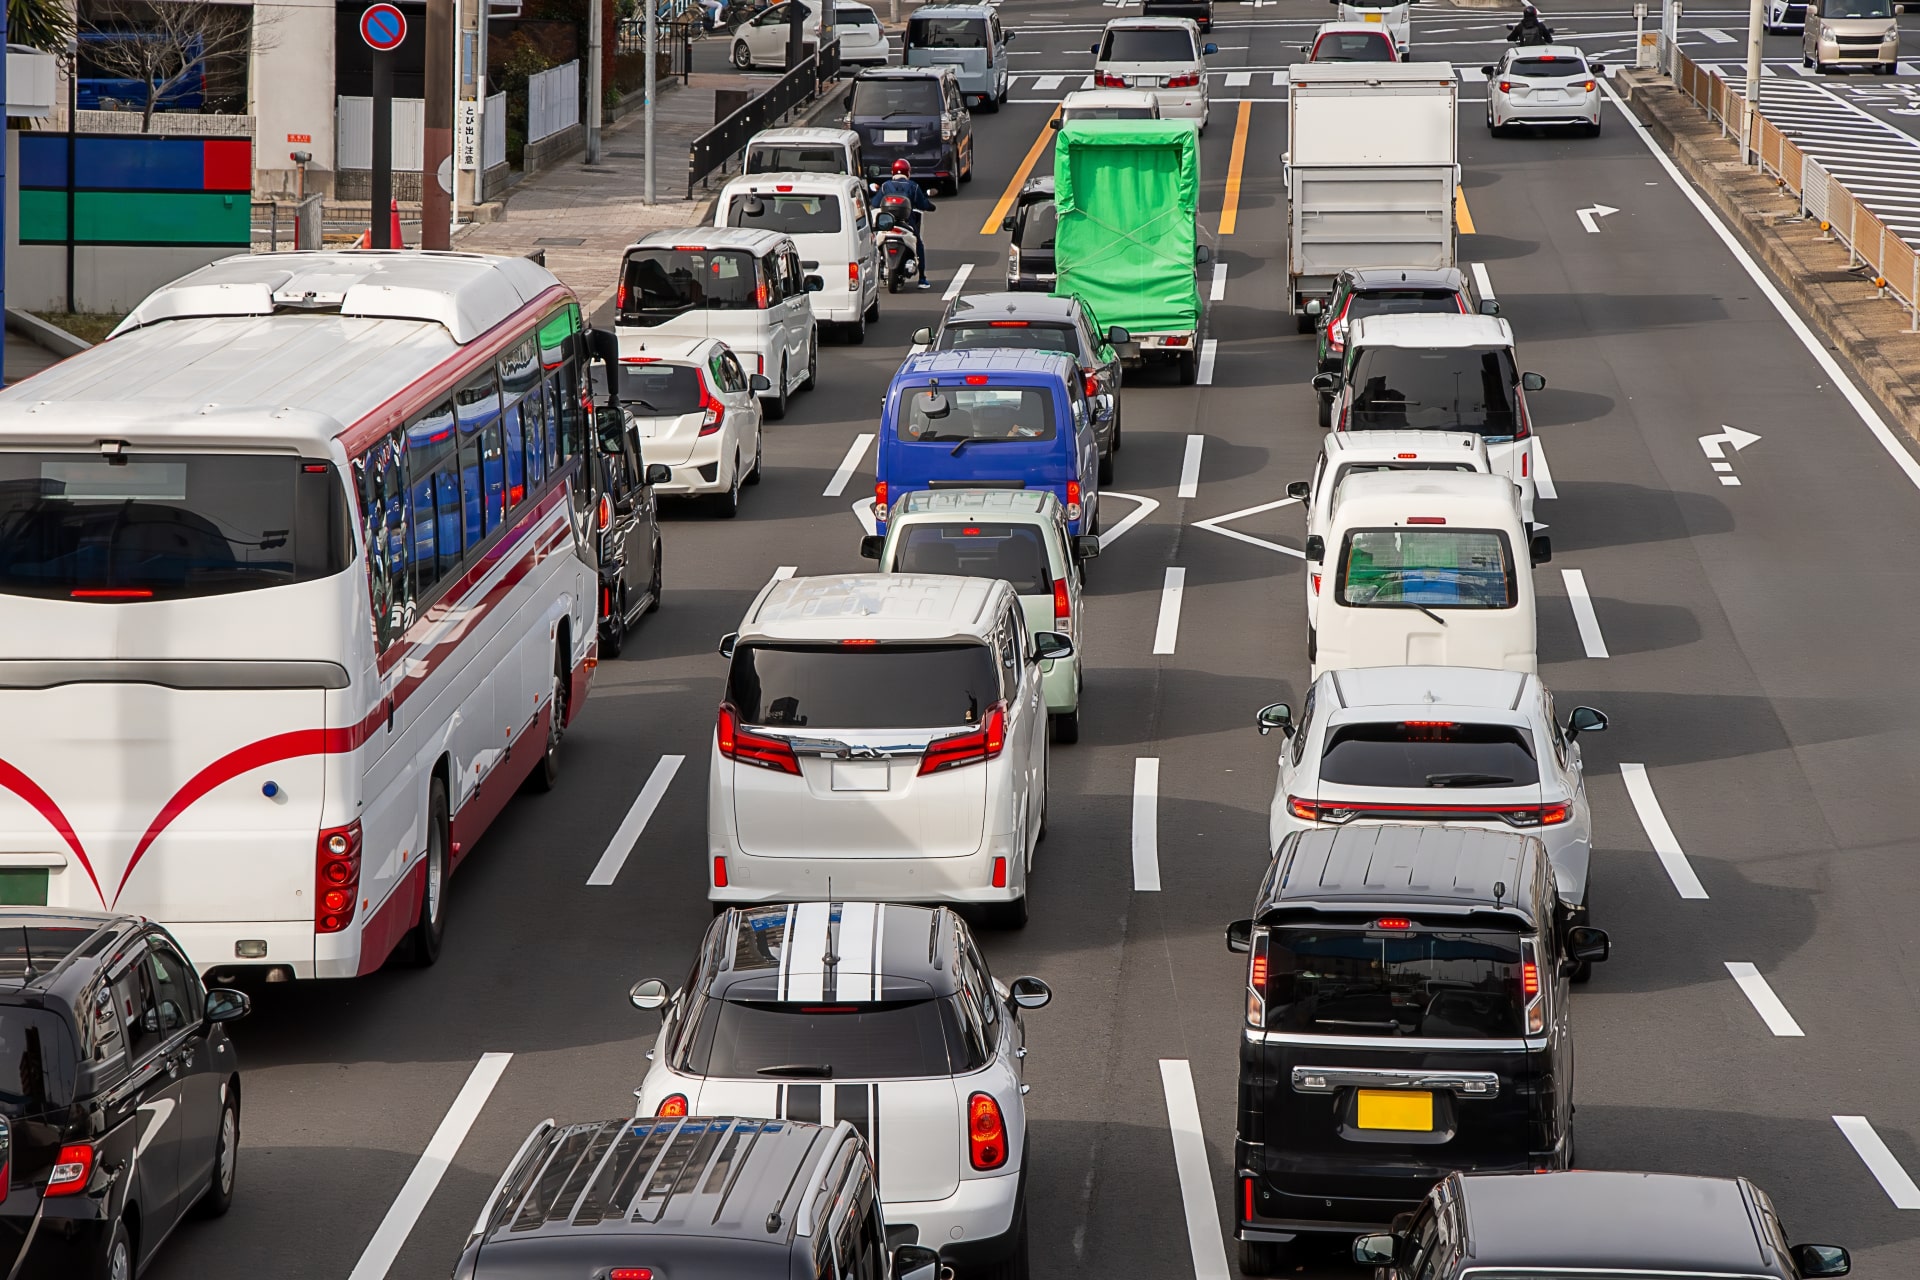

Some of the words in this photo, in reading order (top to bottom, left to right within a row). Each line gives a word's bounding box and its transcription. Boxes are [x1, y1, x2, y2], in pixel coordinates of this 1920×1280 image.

[465, 106, 474, 164] とび出し注意
